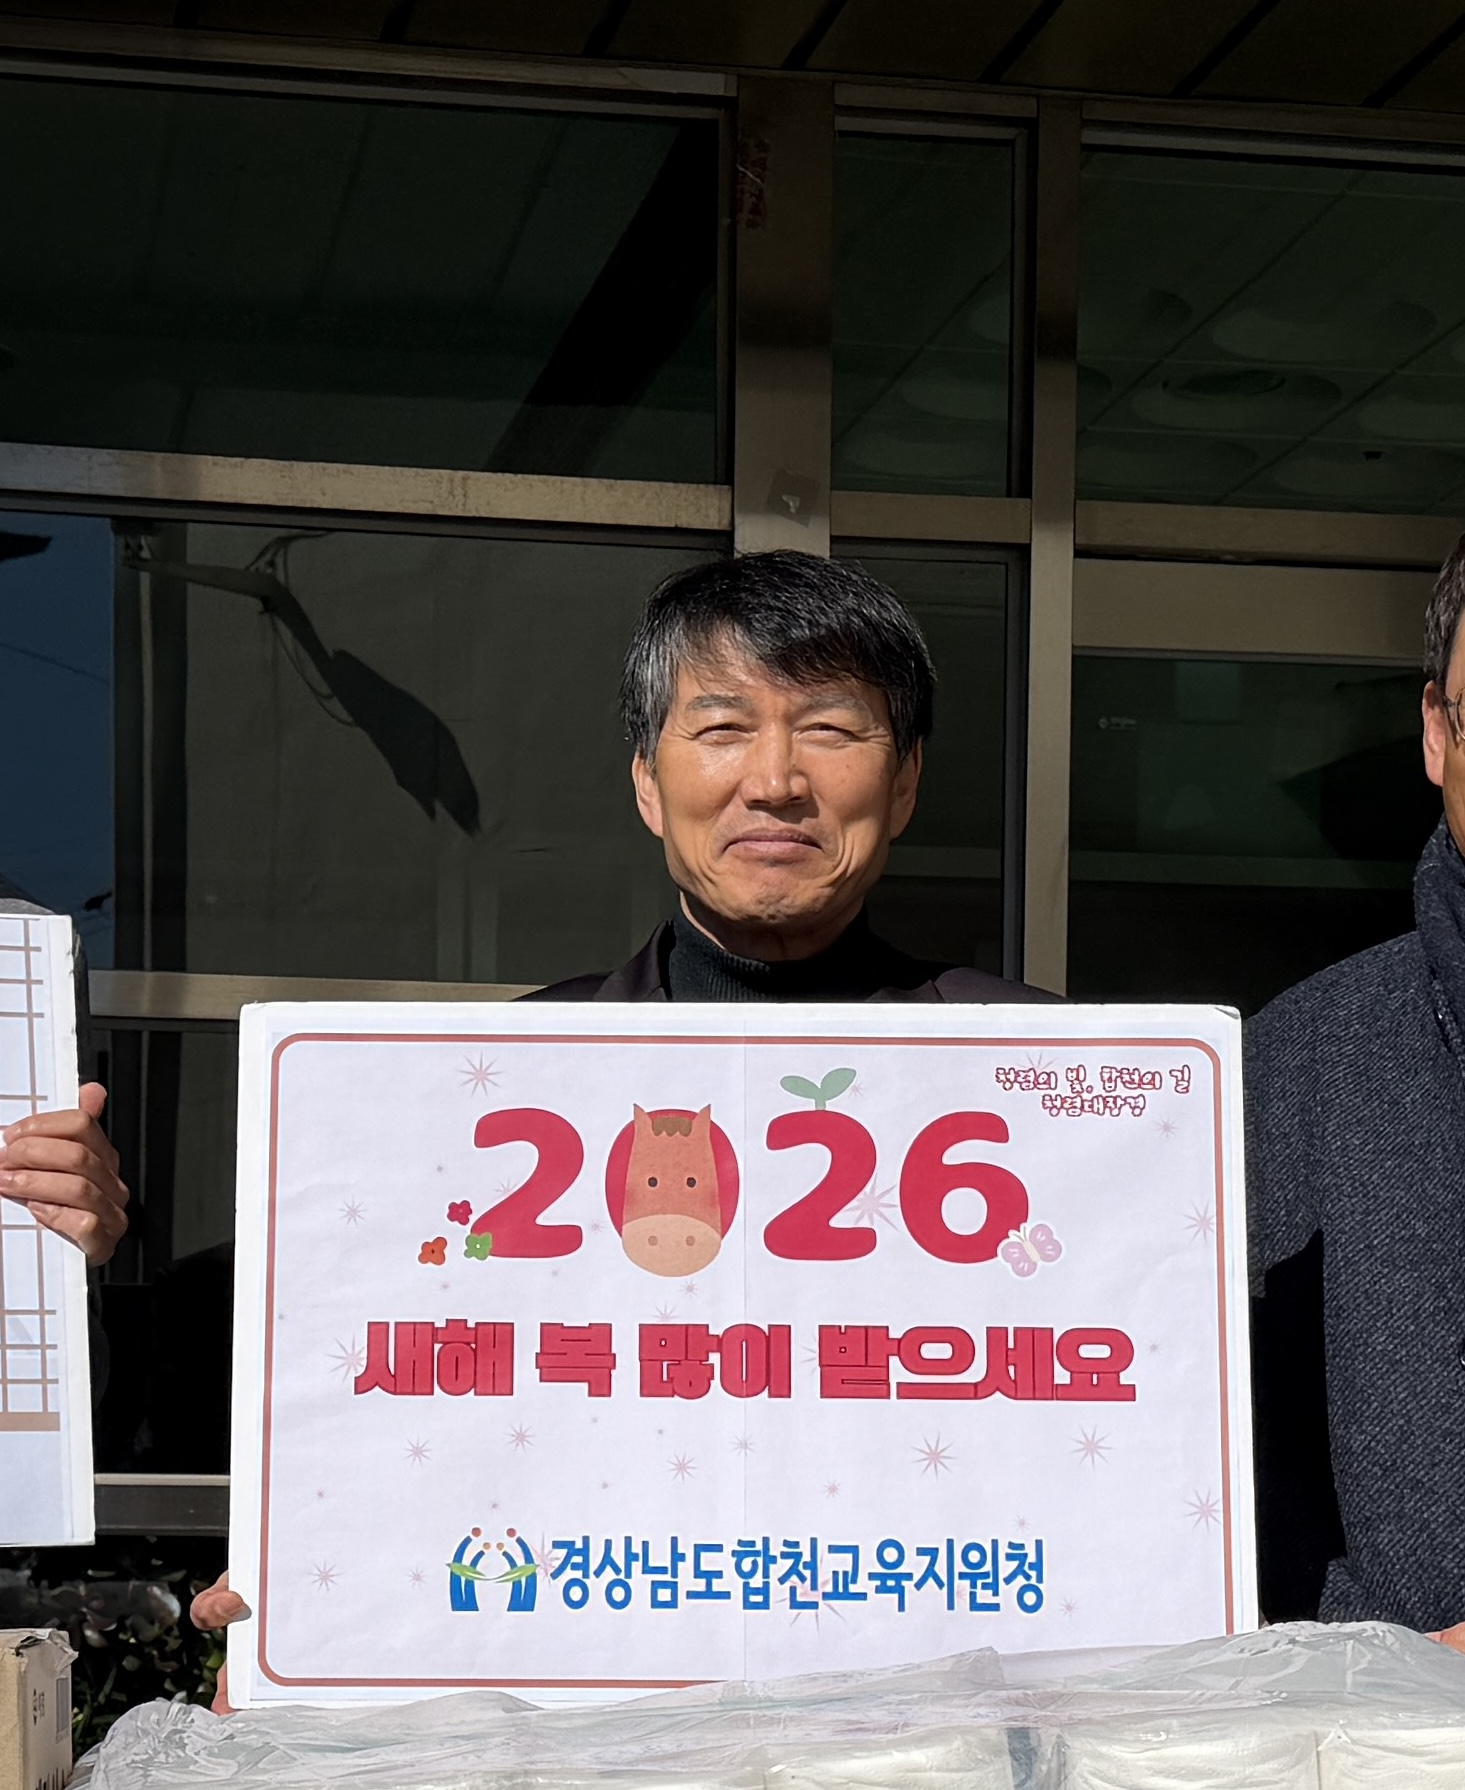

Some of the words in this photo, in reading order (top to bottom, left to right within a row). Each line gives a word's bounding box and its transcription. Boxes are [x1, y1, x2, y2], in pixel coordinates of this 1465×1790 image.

[1169, 1064, 1191, 1094] 길
[469, 1107, 1030, 1266] 2026
[353, 1318, 515, 1397] 새해
[535, 1322, 616, 1398] 복
[637, 1321, 793, 1400] 많이
[818, 1324, 1137, 1403] 받으세요
[550, 1536, 1046, 1614] 경상남도합천교육지원청
